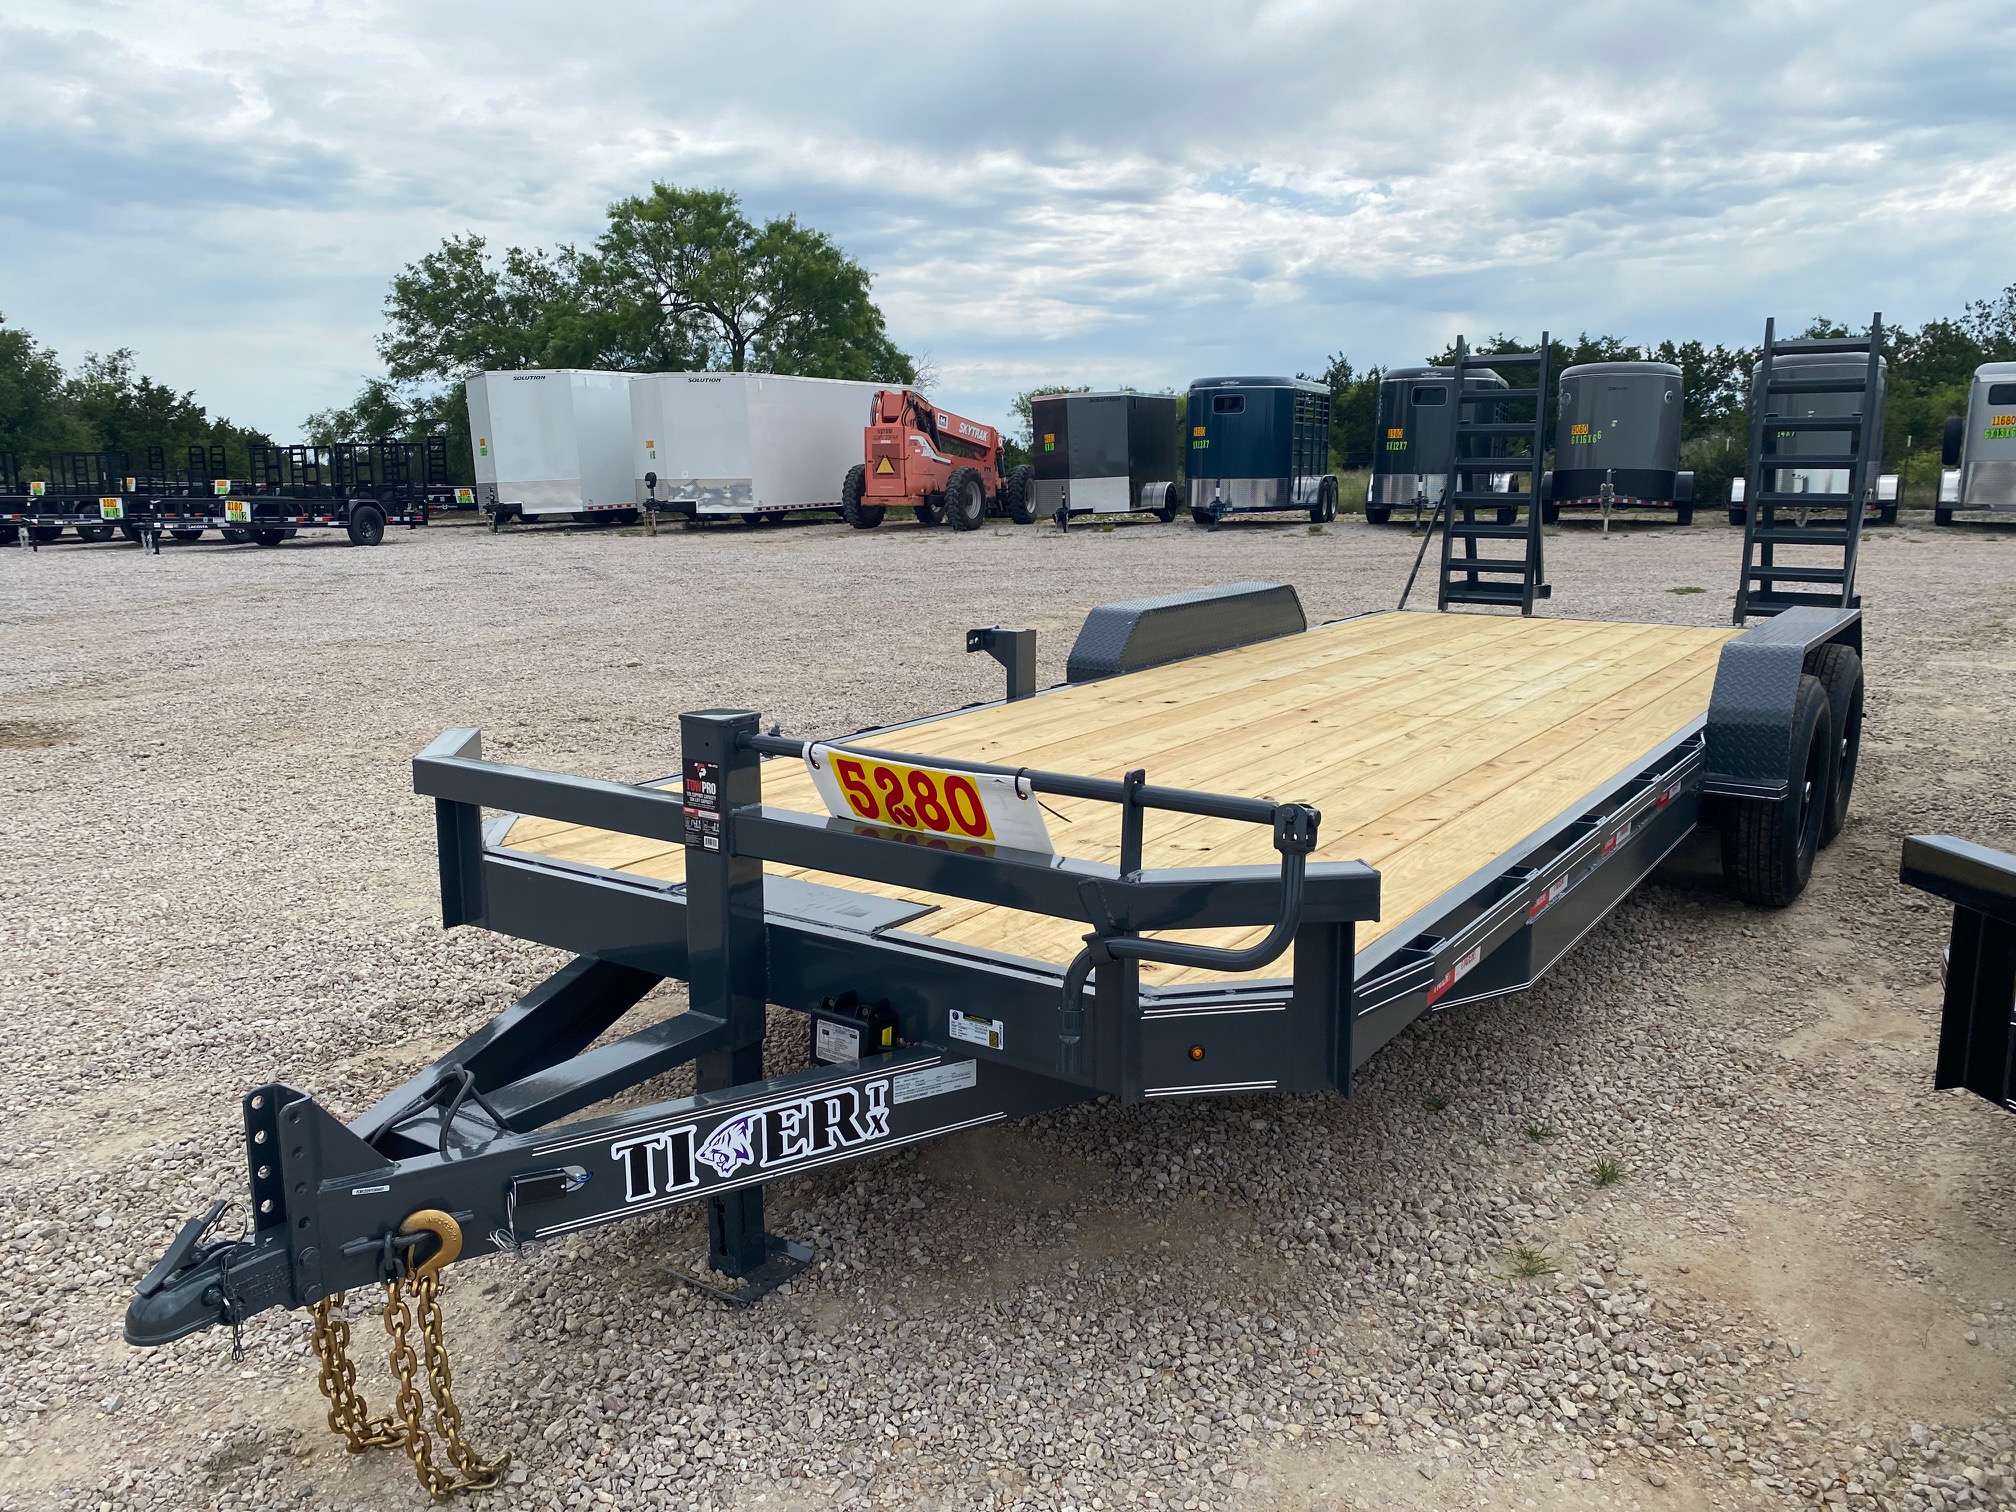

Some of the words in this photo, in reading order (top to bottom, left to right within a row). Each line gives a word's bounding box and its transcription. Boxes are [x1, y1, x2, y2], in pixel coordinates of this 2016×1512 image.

[959, 422, 990, 441] SKYTRAK
[1991, 415, 2016, 426] 11680
[836, 758, 988, 838] 5280
[611, 1087, 863, 1202] TIER
